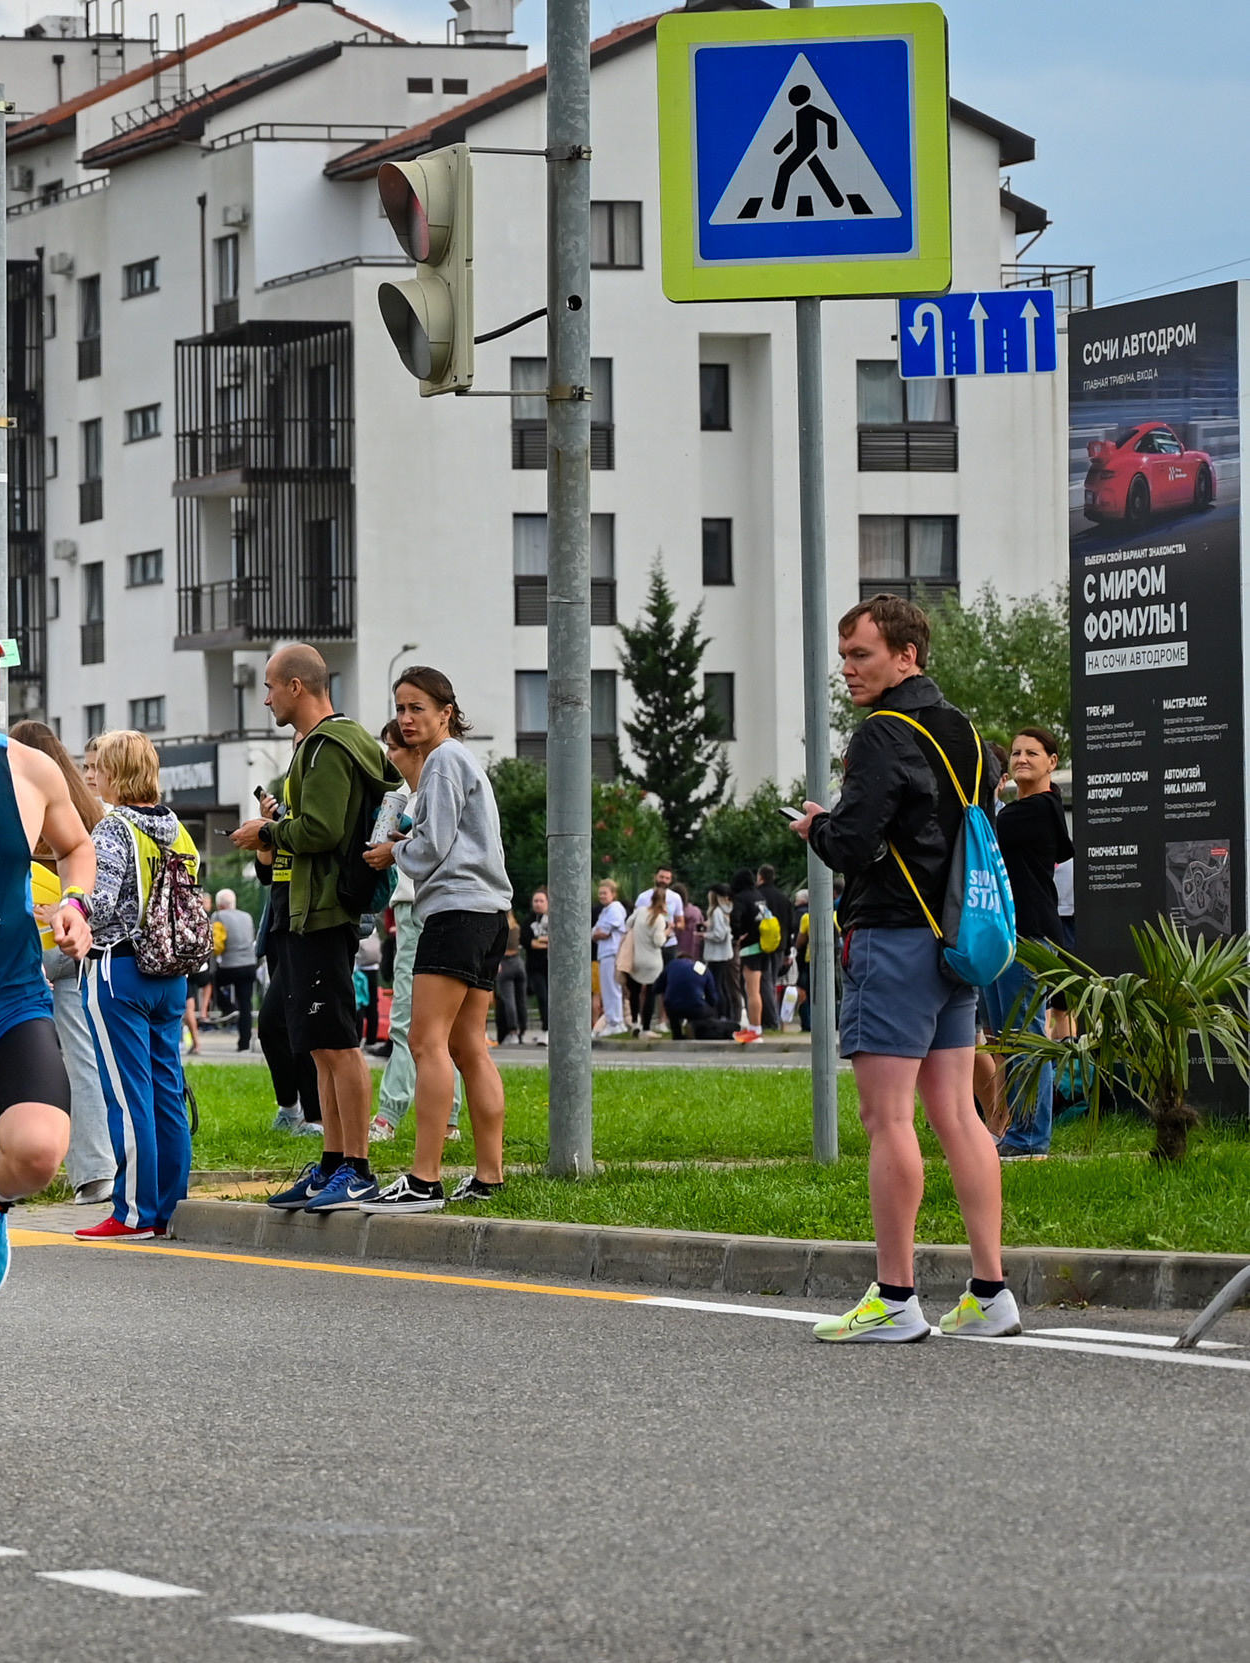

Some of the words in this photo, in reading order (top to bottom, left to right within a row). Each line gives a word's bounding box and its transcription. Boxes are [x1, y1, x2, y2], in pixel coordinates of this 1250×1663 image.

[1083, 338, 1118, 365] СОЧИ
[1122, 322, 1197, 358] АВТОДРОМ
[1083, 377, 1108, 391] ГЛАВНАЯ
[1136, 369, 1154, 382] ВХОД
[1084, 553, 1107, 566] ВЫБЕРИ
[1107, 549, 1122, 563] СВОЙ
[1123, 548, 1148, 561] ВАРИАНТ
[1149, 543, 1186, 557] ЗНАКОМСТВА
[1083, 574, 1096, 604] С
[1100, 565, 1166, 602] МИРОМ
[1084, 603, 1175, 642] ФОРМУЛЫ
[1179, 601, 1187, 631] 1
[1087, 655, 1099, 670] НА
[1102, 653, 1127, 668] СОЧИ
[1130, 647, 1186, 666] АВТОДРОМЕ
[1086, 704, 1115, 718] ТРЕК-ДНИ
[1163, 696, 1208, 710] МАСТЕР-КЛАСС
[1087, 772, 1122, 785] ЭКСКУРСИИ
[1122, 772, 1131, 783] ПО
[1131, 771, 1149, 782] СОЧИ
[1164, 764, 1201, 780] АВТОМУЗЕЙ
[1087, 787, 1123, 801] АВТОДРОМУ
[1164, 783, 1181, 795] НИКА
[1088, 846, 1118, 858] ГОНОЧНОЕ
[1118, 845, 1138, 856] ТАКСИ
